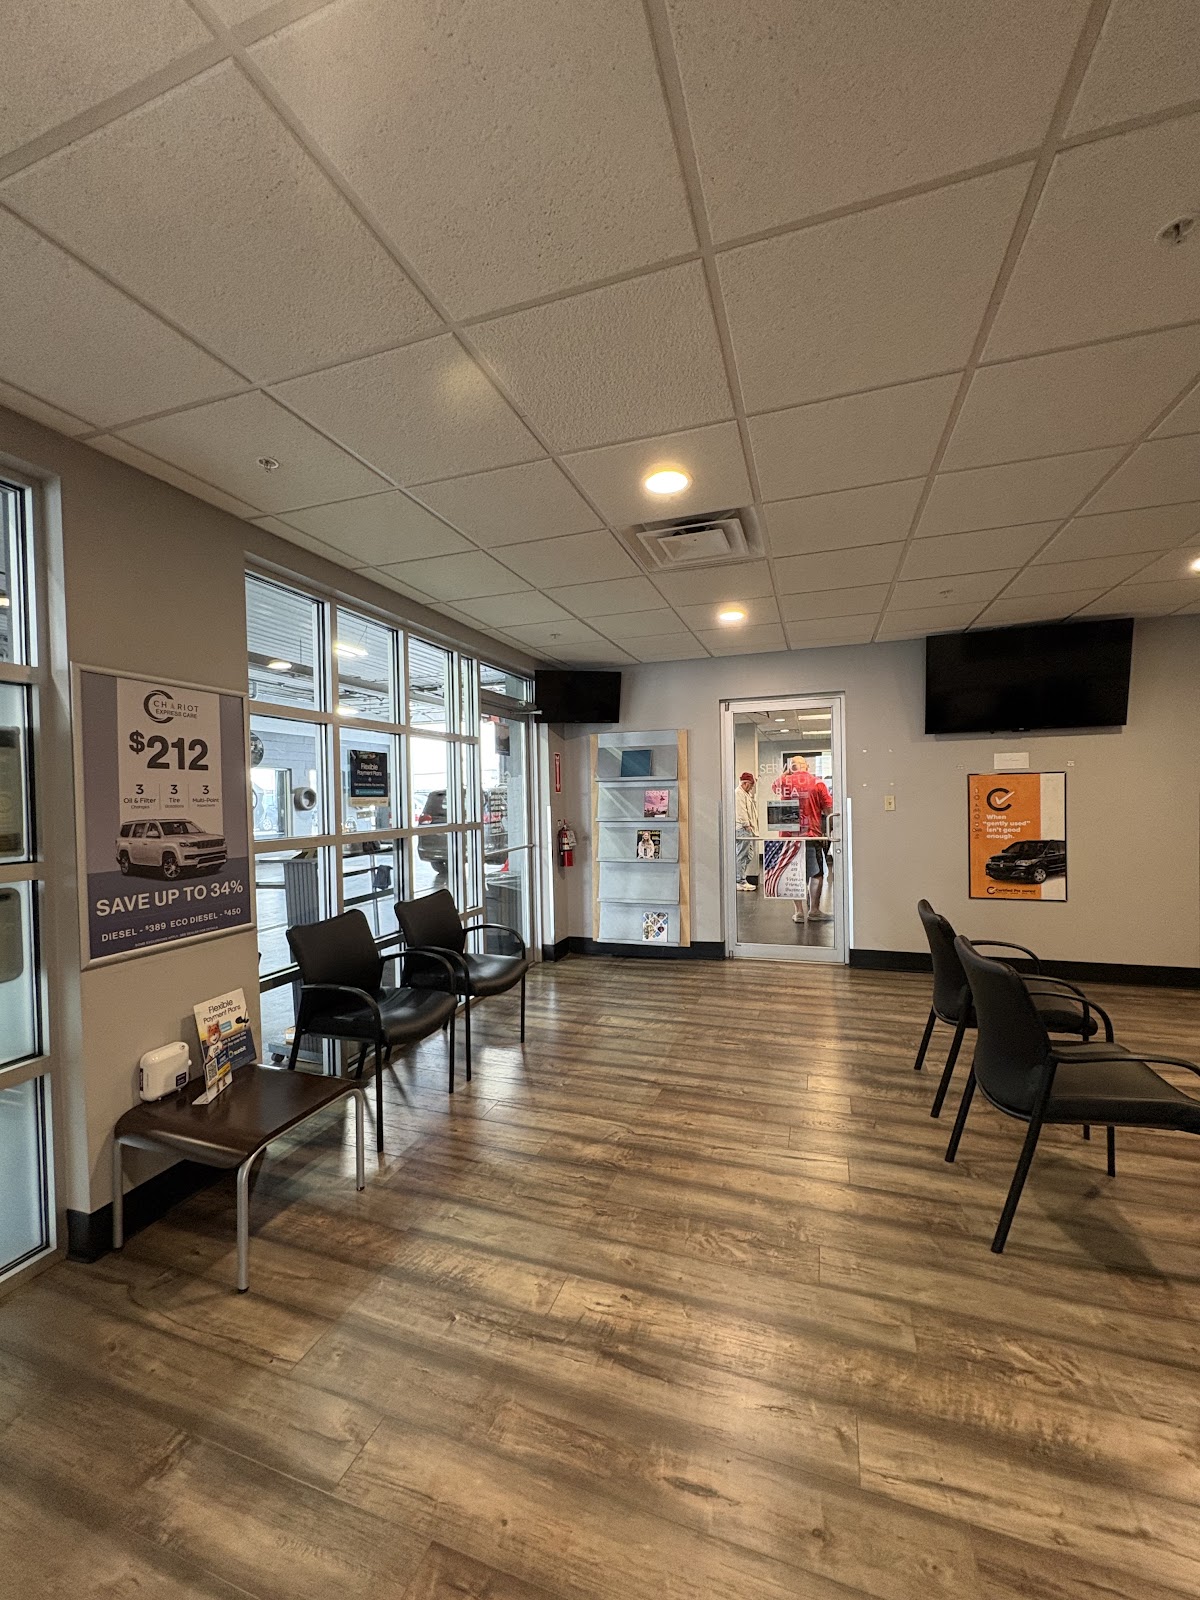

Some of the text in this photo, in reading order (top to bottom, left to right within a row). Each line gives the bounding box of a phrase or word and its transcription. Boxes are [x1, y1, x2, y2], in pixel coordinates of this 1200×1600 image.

[153, 700, 199, 712] CHARIOT
[156, 708, 198, 720] EXPRESS CARE
[129, 730, 208, 771] $212
[360, 762, 378, 770] Flexible
[136, 784, 144, 795] 3
[170, 784, 178, 795] 3
[202, 784, 210, 795] 3
[96, 880, 244, 916] SAVE UP TO 34%
[101, 928, 137, 942] DIESEL
[145, 922, 166, 933] $389
[170, 918, 188, 928] ECO
[189, 912, 218, 924] DIESEL
[224, 907, 241, 916] $450
[208, 999, 234, 1014] Flexible
[203, 1004, 241, 1024] Payment Plans
